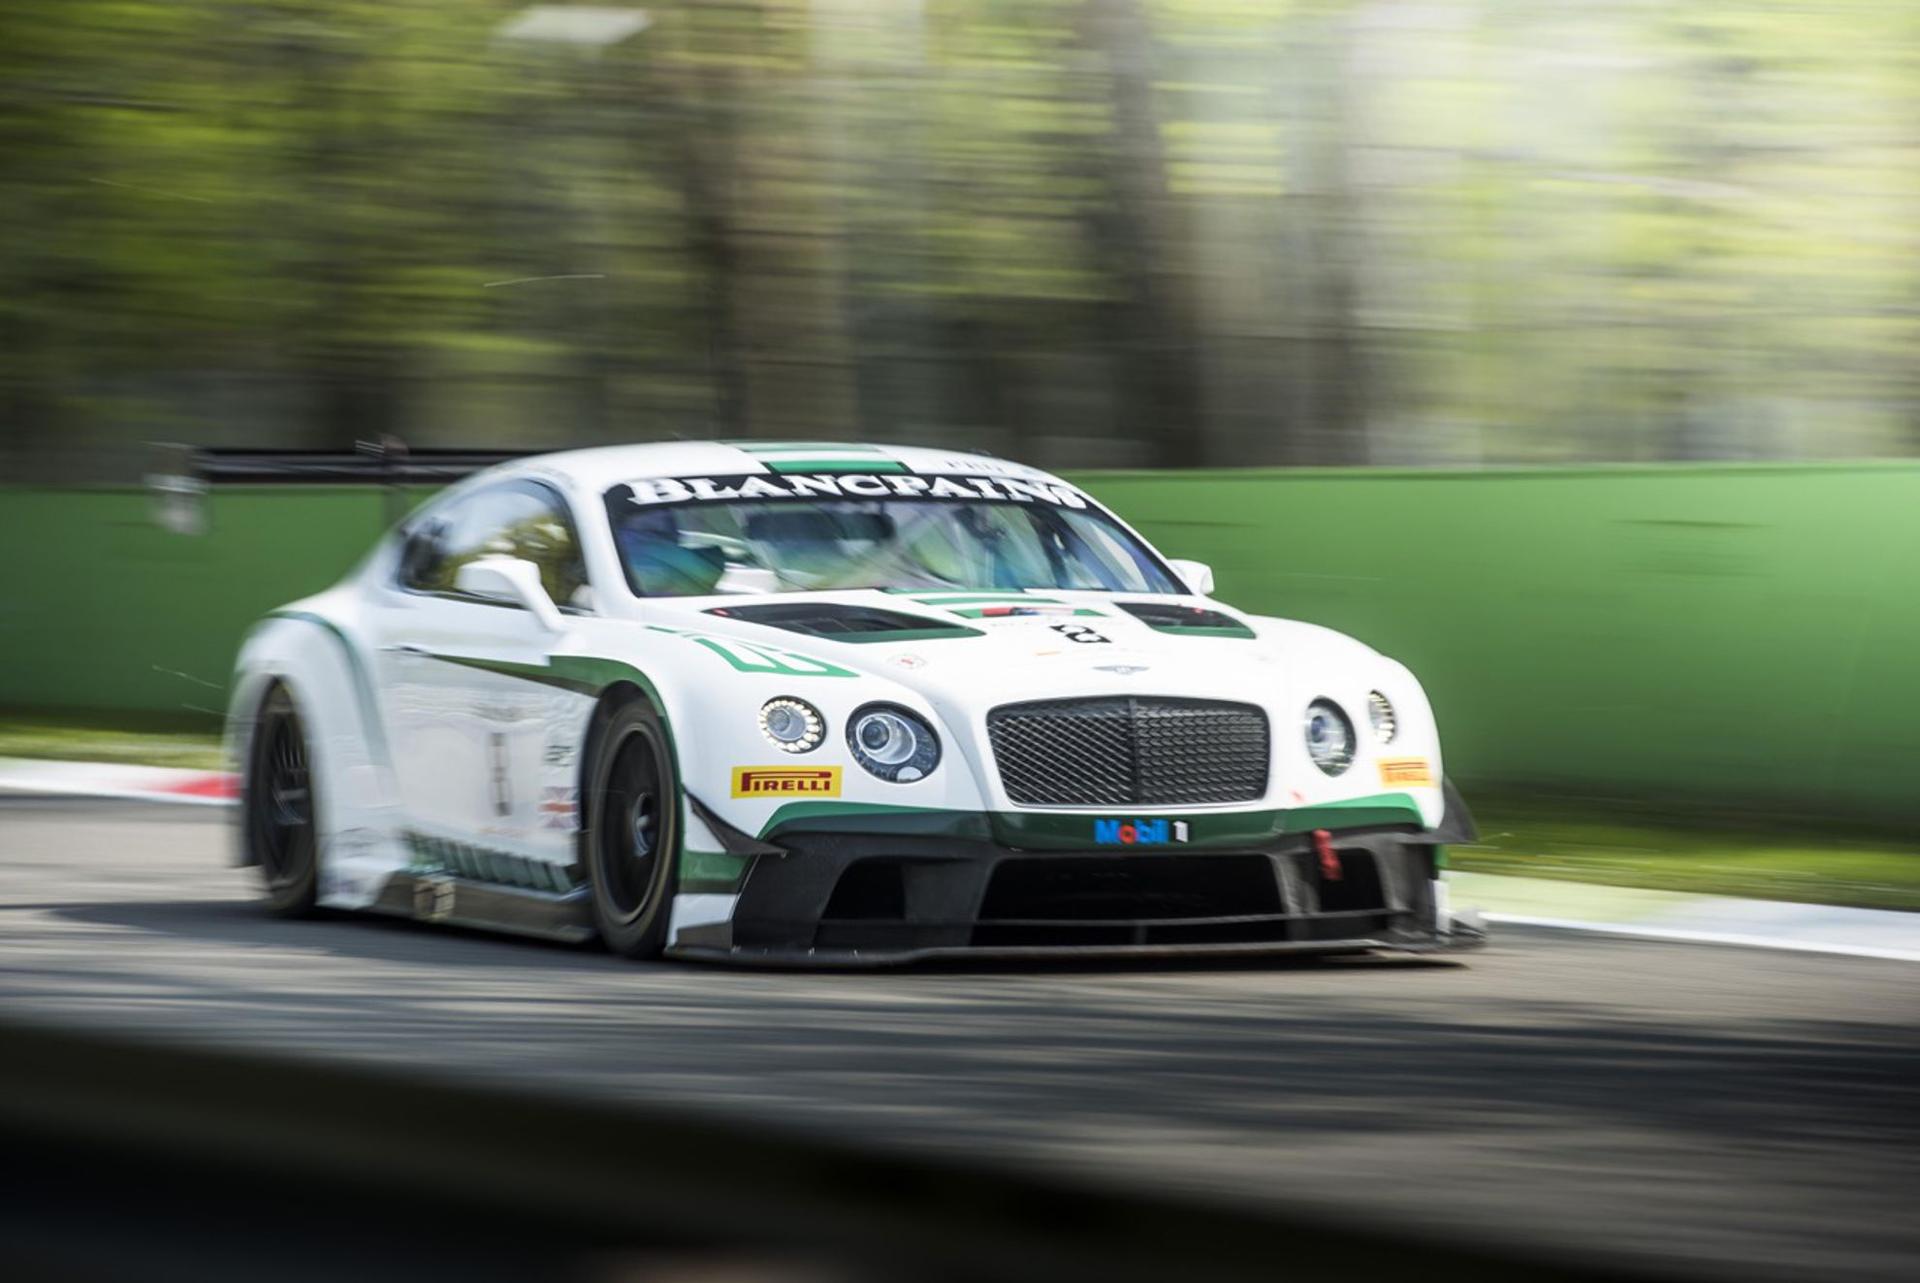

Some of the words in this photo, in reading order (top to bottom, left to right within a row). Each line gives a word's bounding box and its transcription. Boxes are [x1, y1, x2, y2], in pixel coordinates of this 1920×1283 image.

[740, 771, 832, 792] PIRELLI
[1094, 818, 1169, 844] Mobil
[1172, 820, 1189, 843] 1
